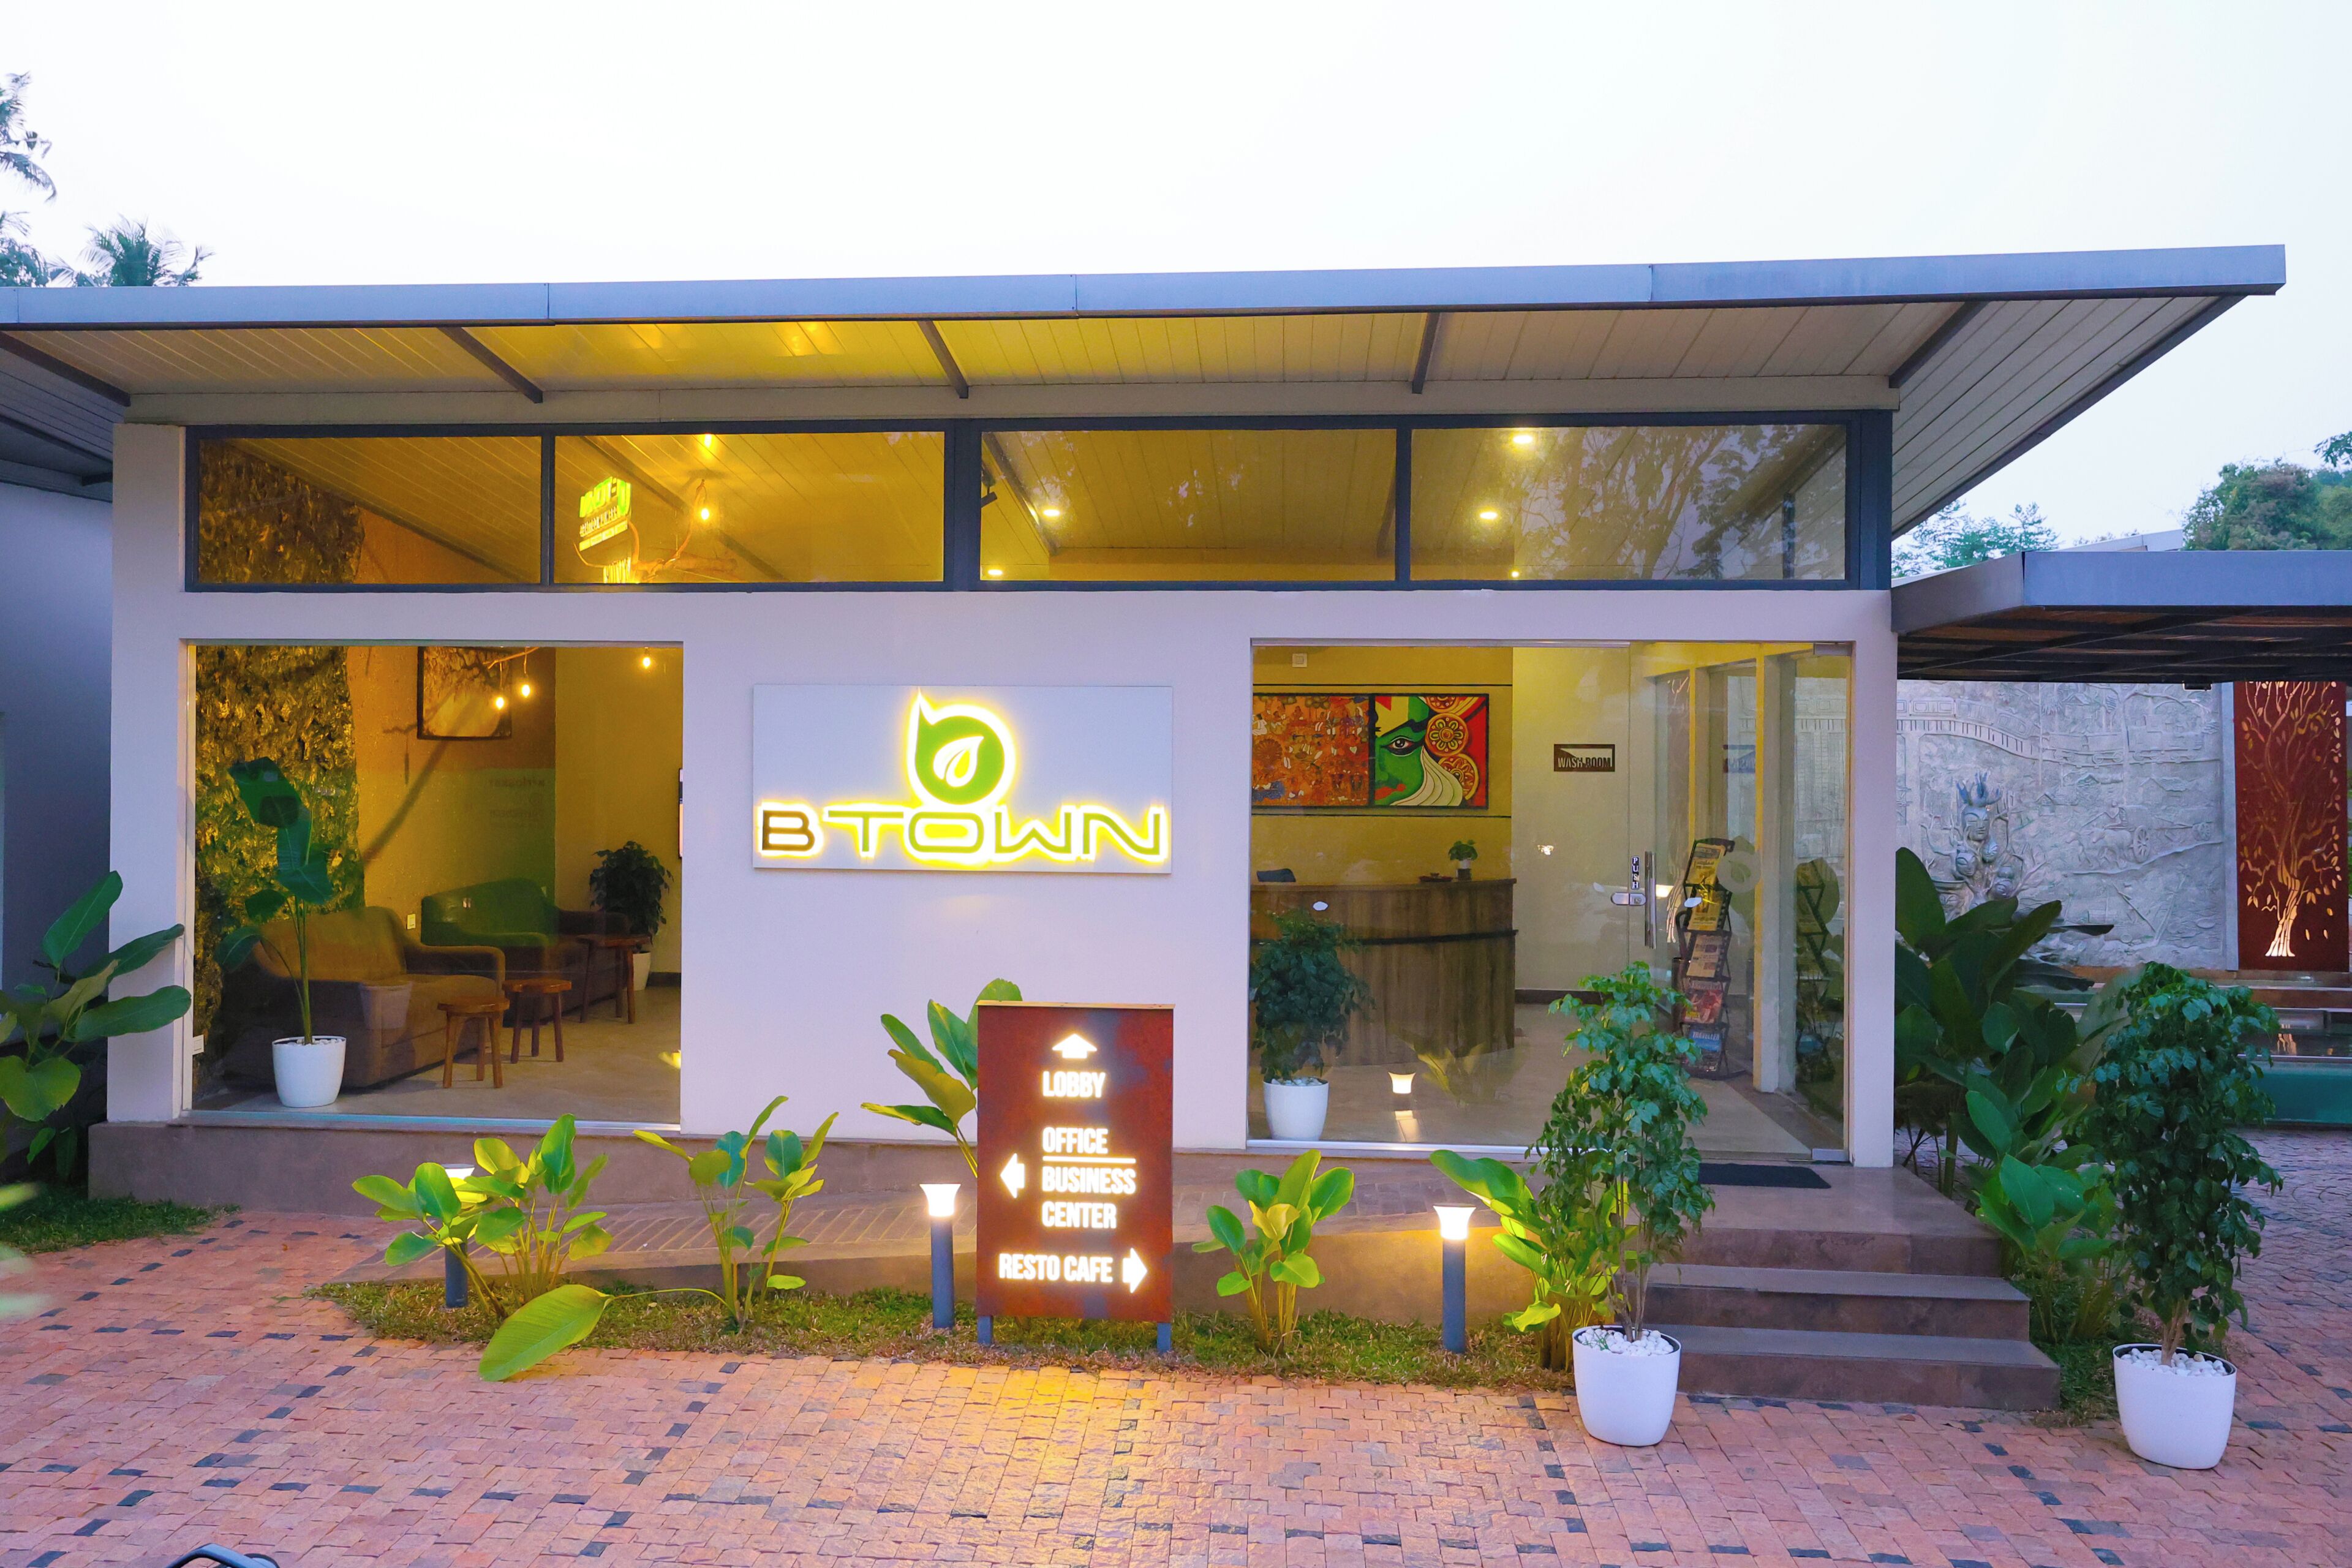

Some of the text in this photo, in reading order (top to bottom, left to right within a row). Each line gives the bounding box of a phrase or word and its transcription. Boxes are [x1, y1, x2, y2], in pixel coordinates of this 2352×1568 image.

[1558, 757, 1583, 768] WASH
[1042, 1071, 1106, 1098] LOBBY
[1042, 1126, 1109, 1154] OFFICE
[1042, 1166, 1136, 1194] BUSINESS
[1042, 1200, 1117, 1229] CENTER
[999, 1253, 1114, 1283] RESTO CAFE
